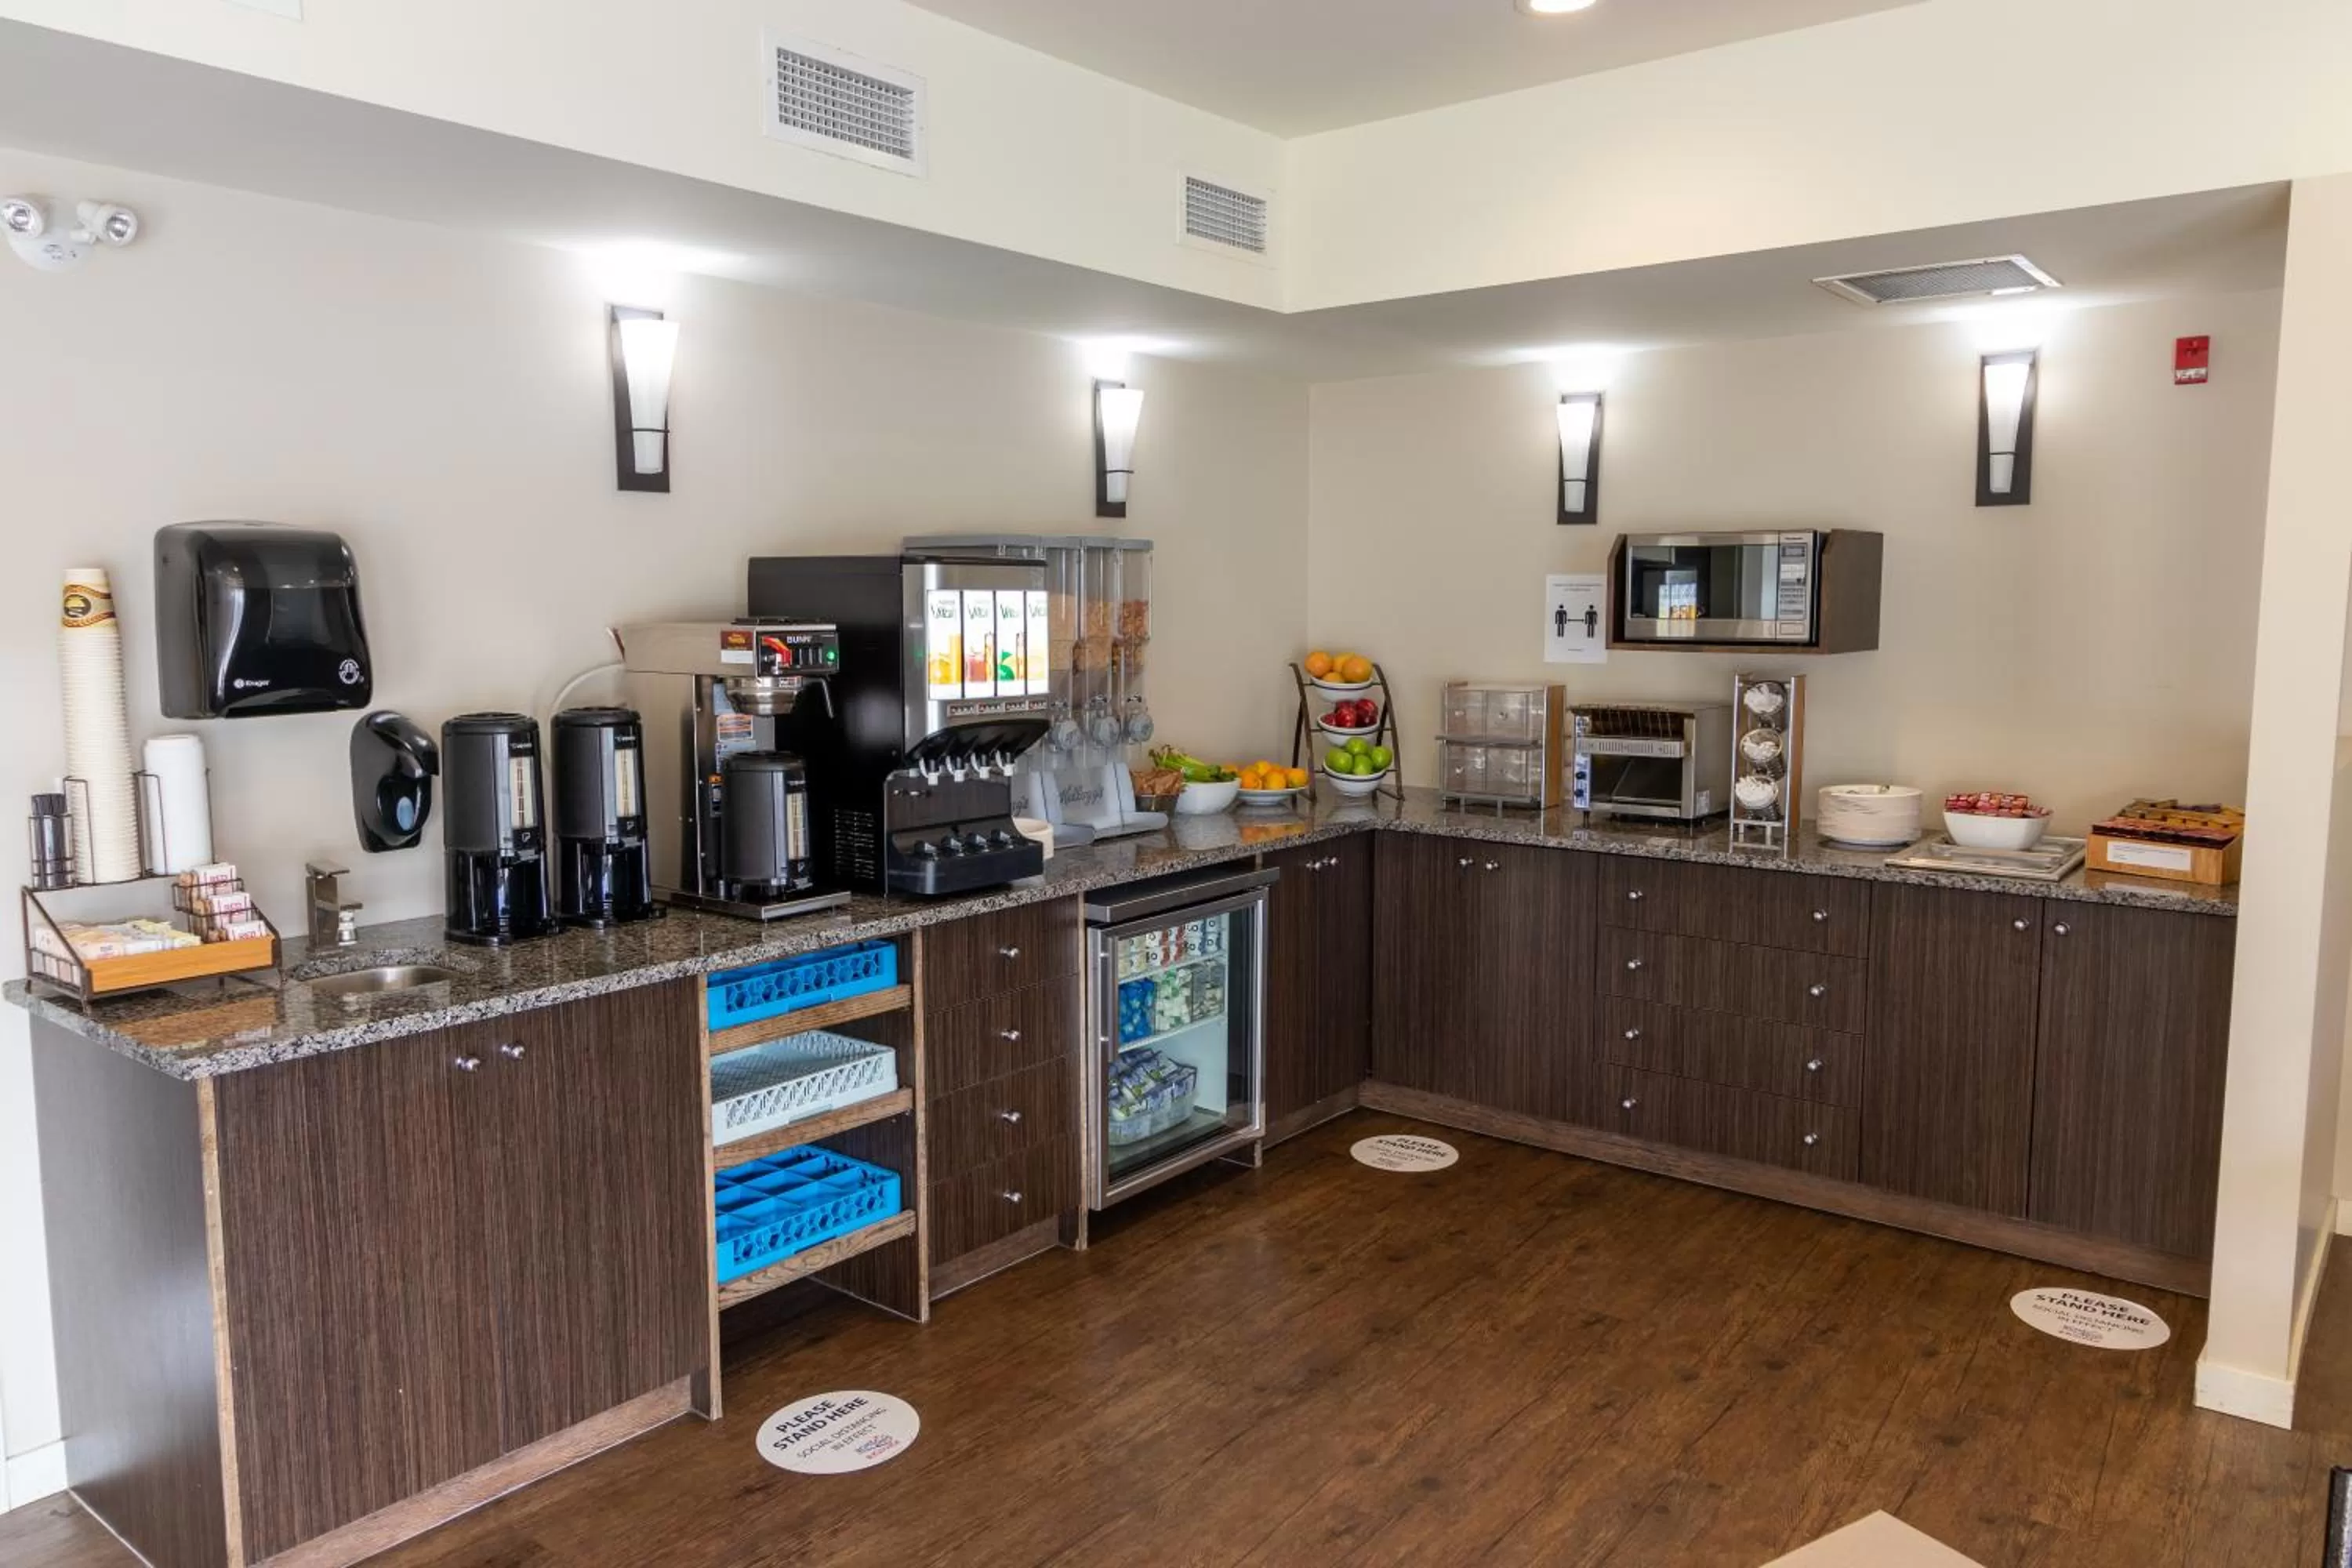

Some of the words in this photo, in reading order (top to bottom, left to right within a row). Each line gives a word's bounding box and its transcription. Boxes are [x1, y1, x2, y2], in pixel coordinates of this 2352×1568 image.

[2036, 1294, 2097, 1312] STAND
[2102, 1309, 2151, 1326] HERE
[2062, 1293, 2129, 1312] PLEASE
[773, 1419, 827, 1450] STAND
[825, 1396, 869, 1421] HERE
[775, 1399, 836, 1433] PLEASE
[797, 1437, 833, 1458] SOCIAL
[831, 1406, 887, 1439] DISTANCING
